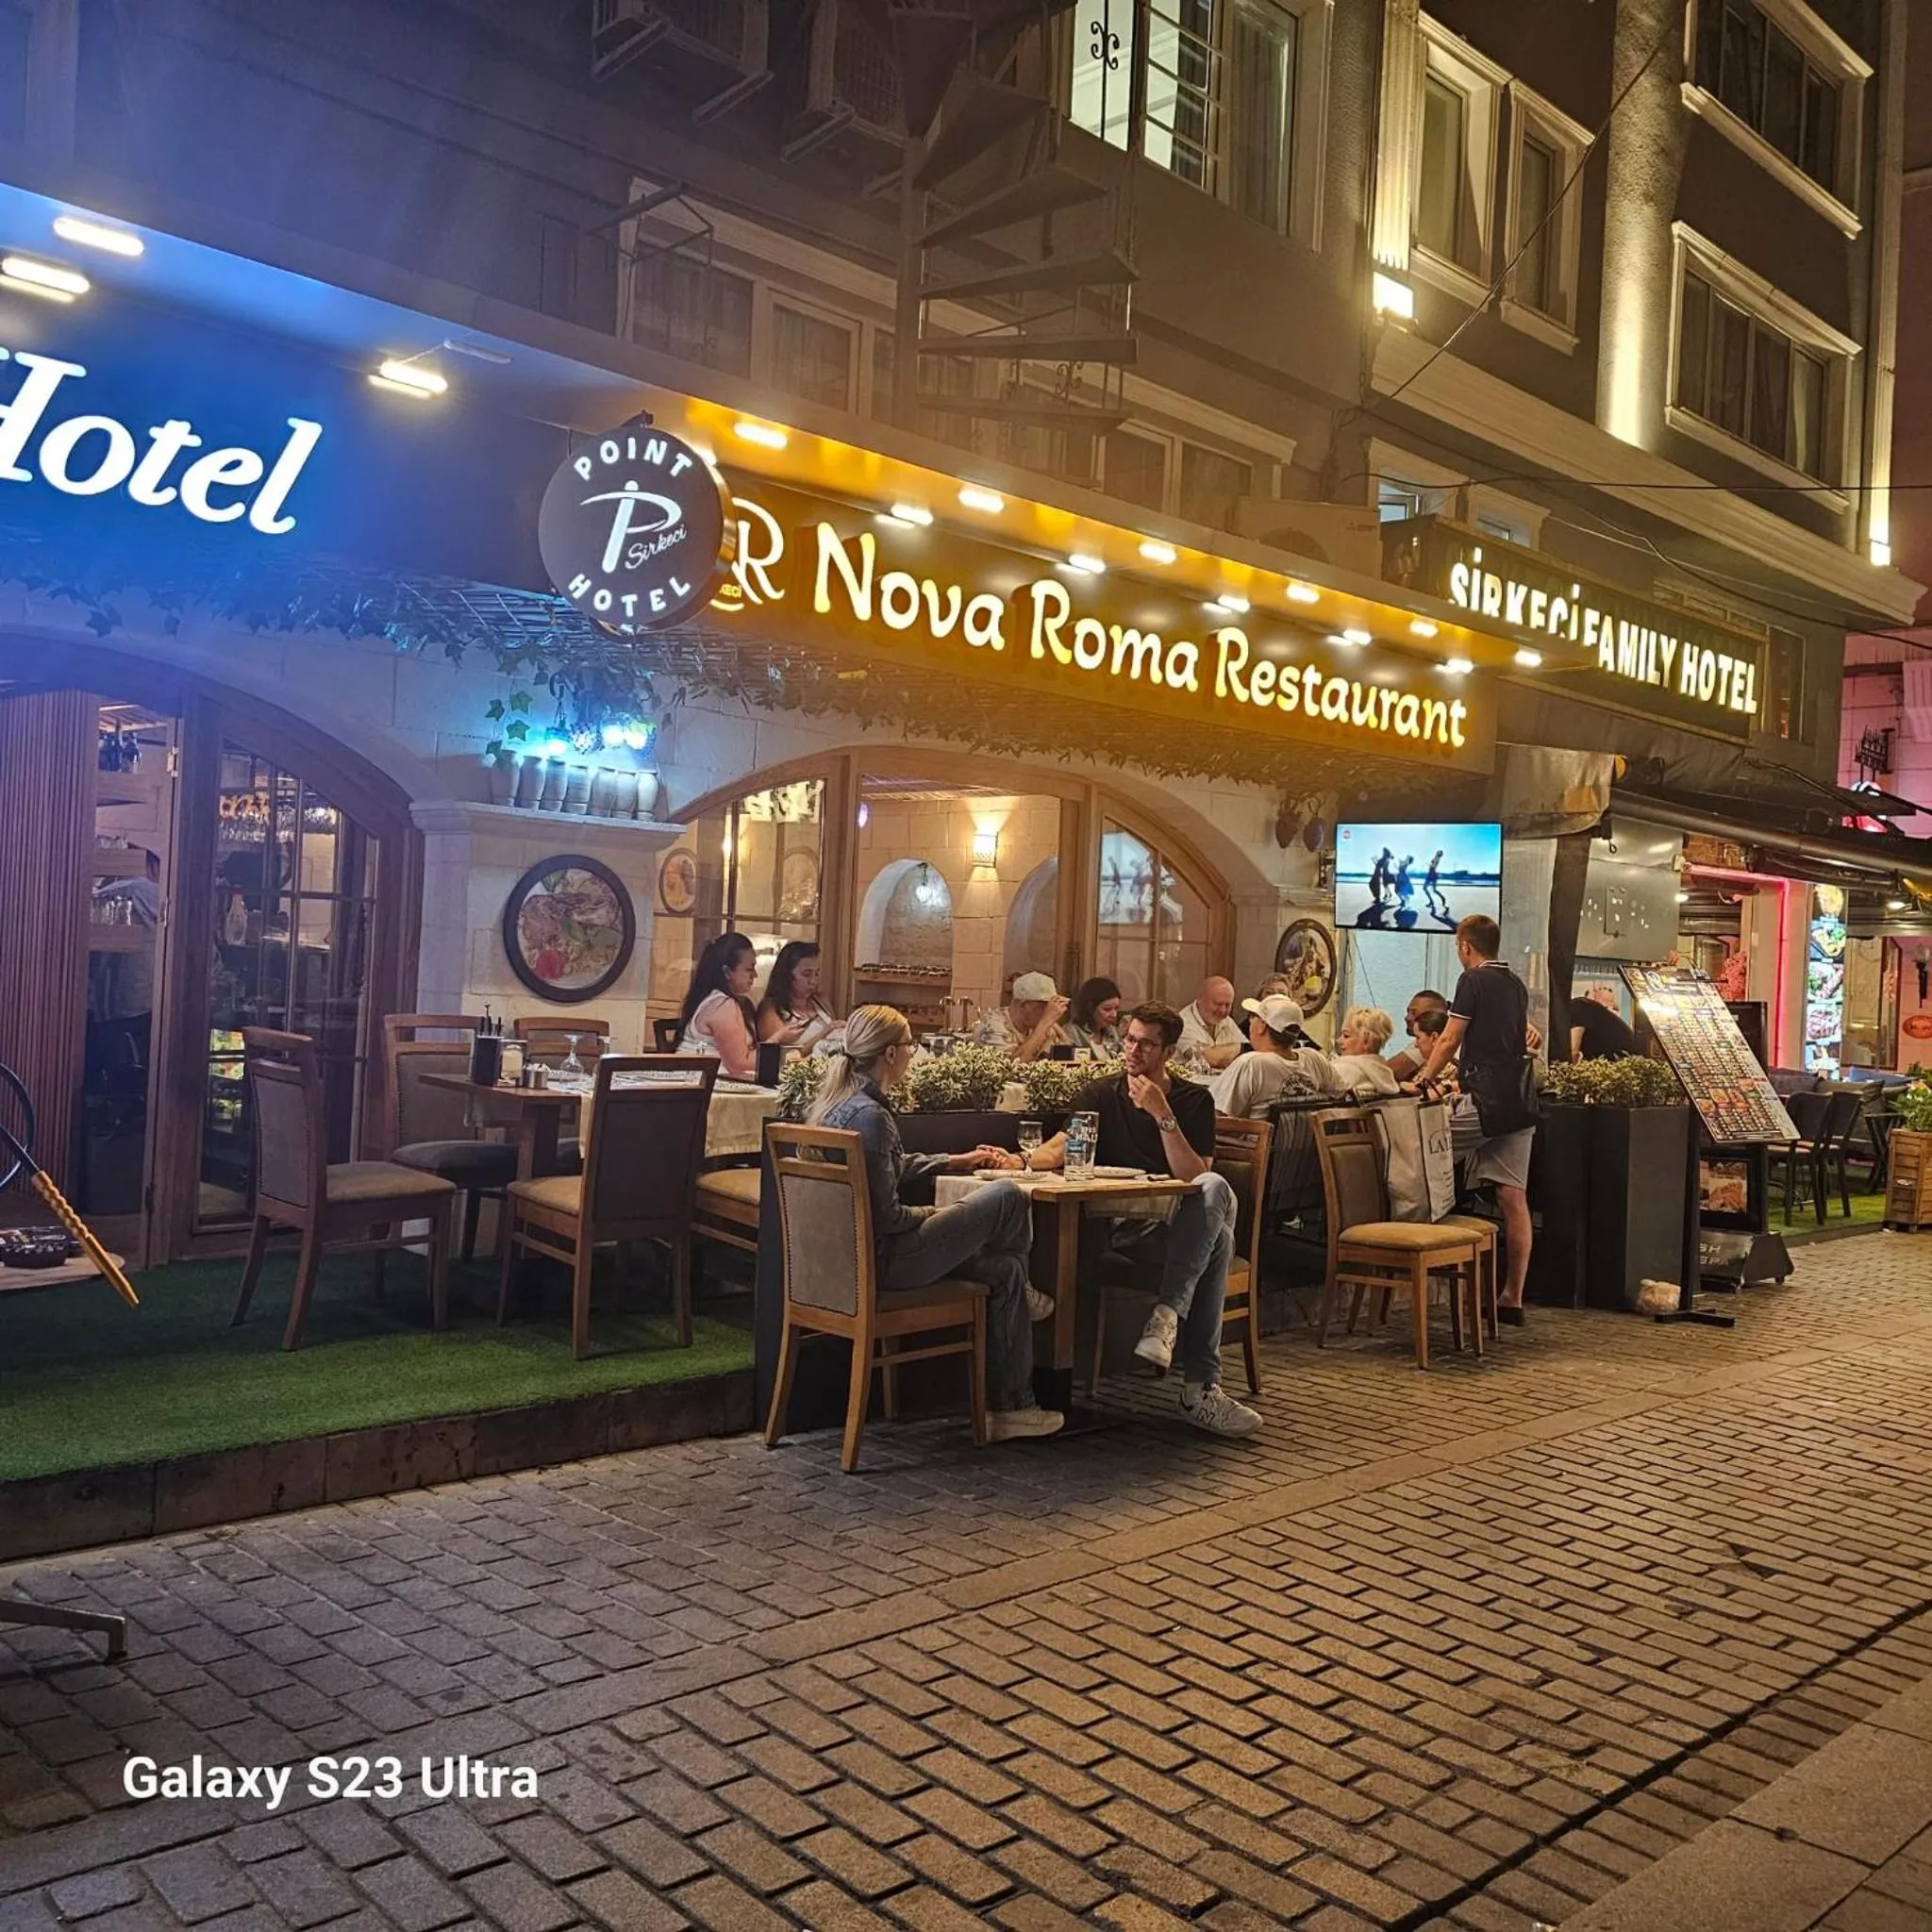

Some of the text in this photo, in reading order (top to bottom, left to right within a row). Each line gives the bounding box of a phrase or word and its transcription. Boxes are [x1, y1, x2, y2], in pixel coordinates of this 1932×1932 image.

[574, 437, 692, 481] POINT
[625, 524, 687, 570] Sirkeci
[567, 573, 691, 618] HOTEL
[814, 522, 1468, 747] Nova Roma Restaurant
[1582, 608, 1678, 687] FAMILY
[1679, 641, 1758, 714] HOTEL
